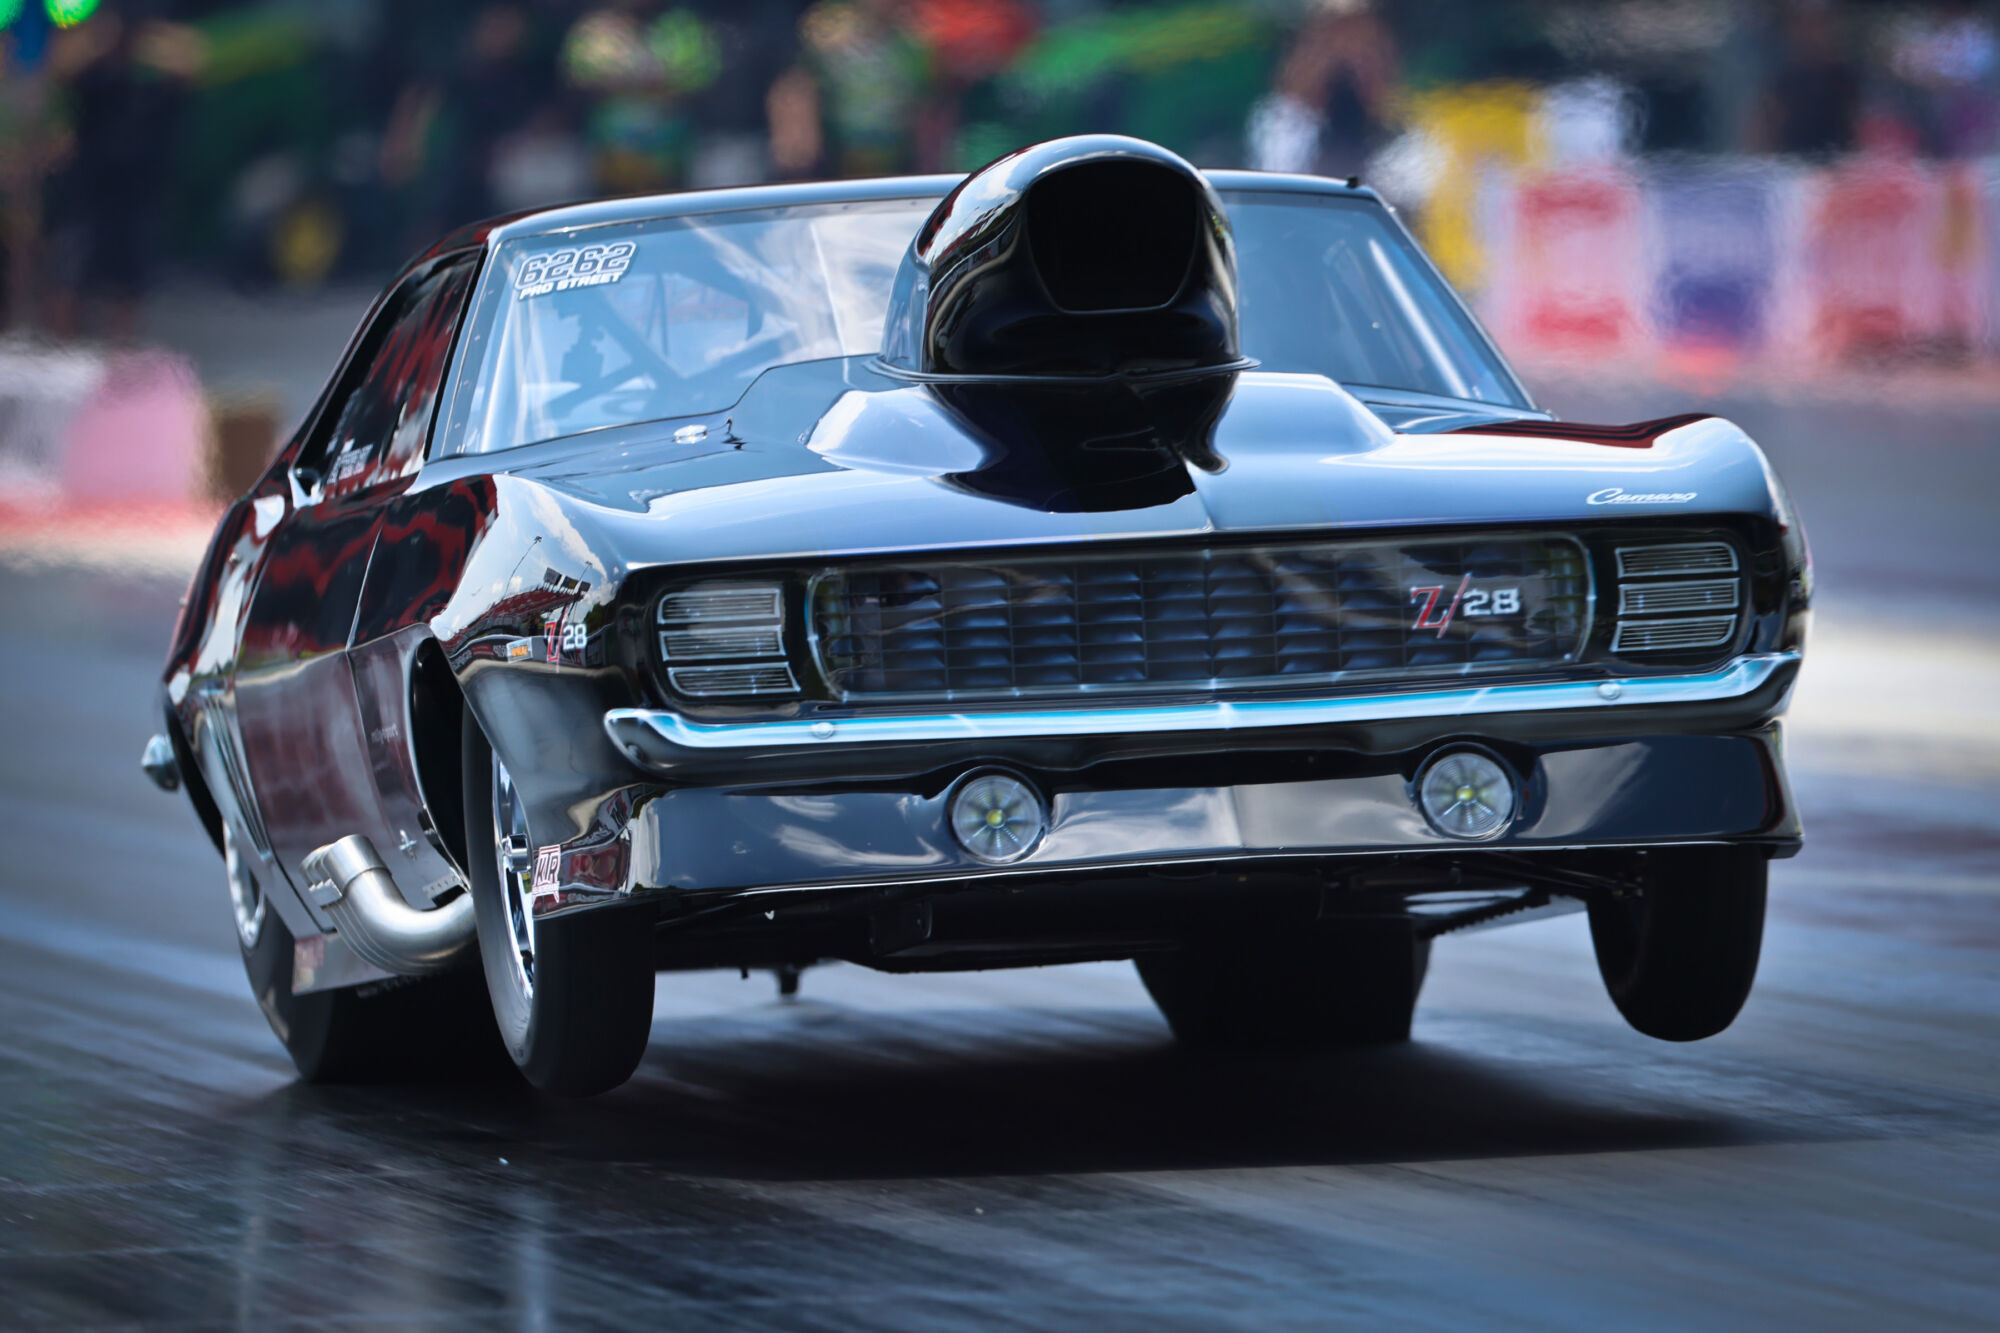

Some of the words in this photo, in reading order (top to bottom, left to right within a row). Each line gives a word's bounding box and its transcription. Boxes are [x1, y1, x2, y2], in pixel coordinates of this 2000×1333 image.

[515, 242, 636, 289] 6262
[519, 282, 554, 300] PRO
[556, 272, 622, 291] STREET
[1586, 487, 1697, 505] Camaro
